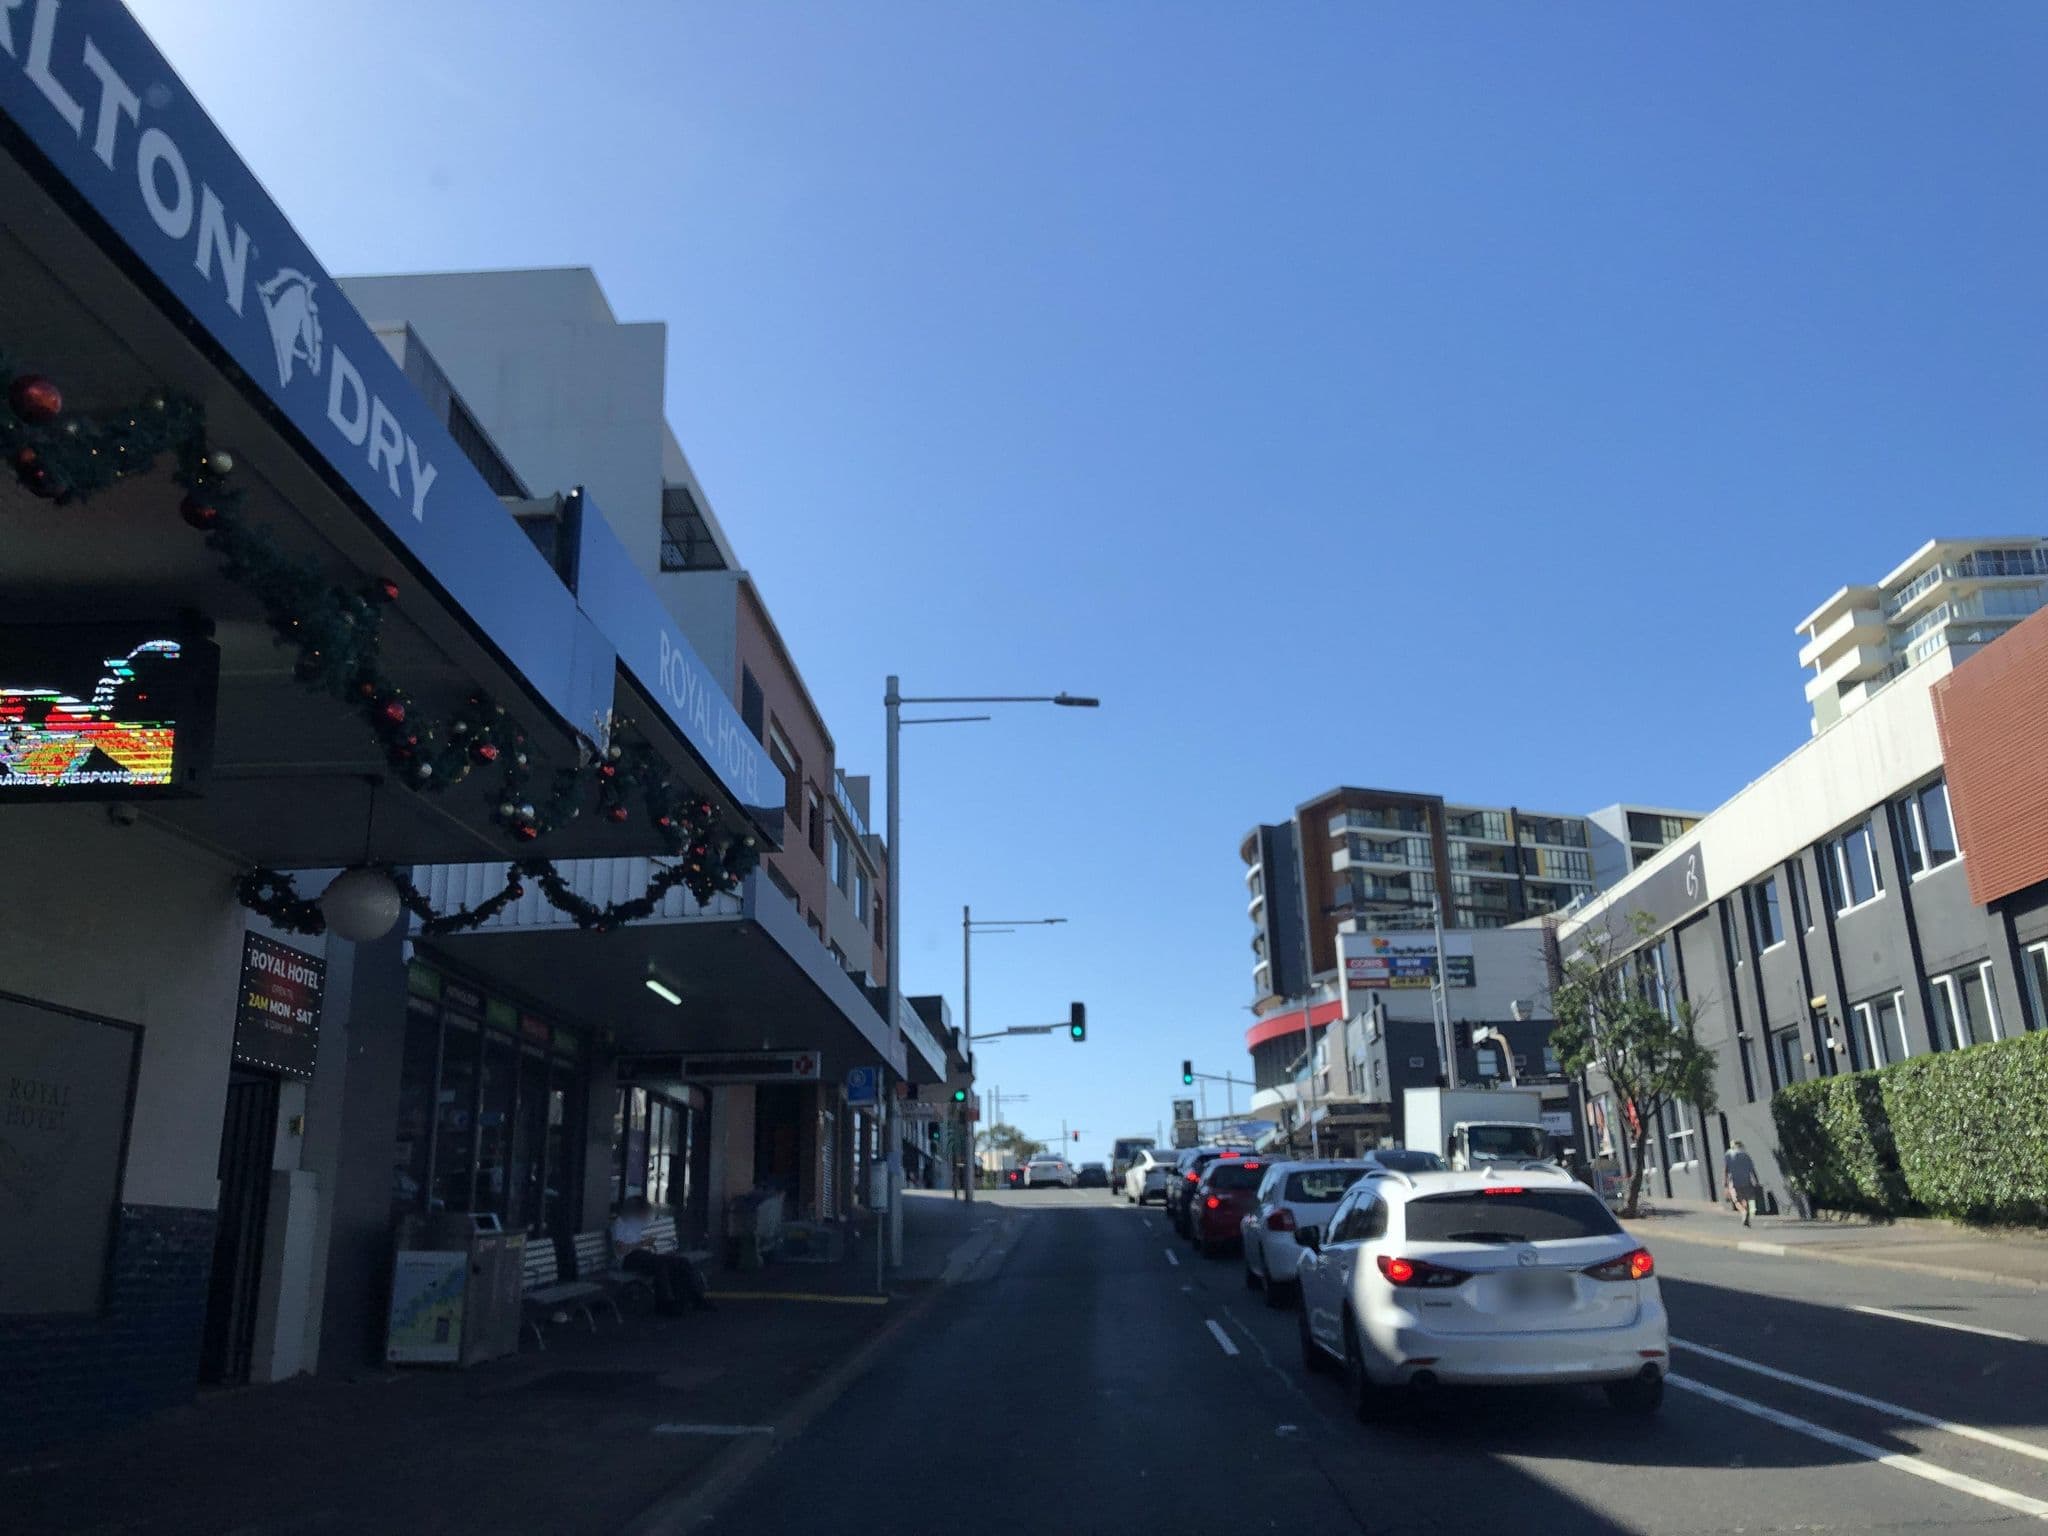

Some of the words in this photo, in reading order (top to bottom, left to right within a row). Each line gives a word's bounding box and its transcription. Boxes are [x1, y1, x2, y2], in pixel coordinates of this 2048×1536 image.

[327, 345, 438, 522] DRY
[659, 628, 714, 748] ROYAL
[717, 706, 760, 805] HOTEL
[58, 768, 168, 785] RESPONSIBLY
[250, 949, 286, 978] ROYAL
[287, 964, 319, 990] HOTEL
[248, 992, 269, 1011] 2AM
[269, 1000, 291, 1019] MON
[296, 1008, 314, 1025] SAT
[9, 1077, 71, 1108] ROYAL
